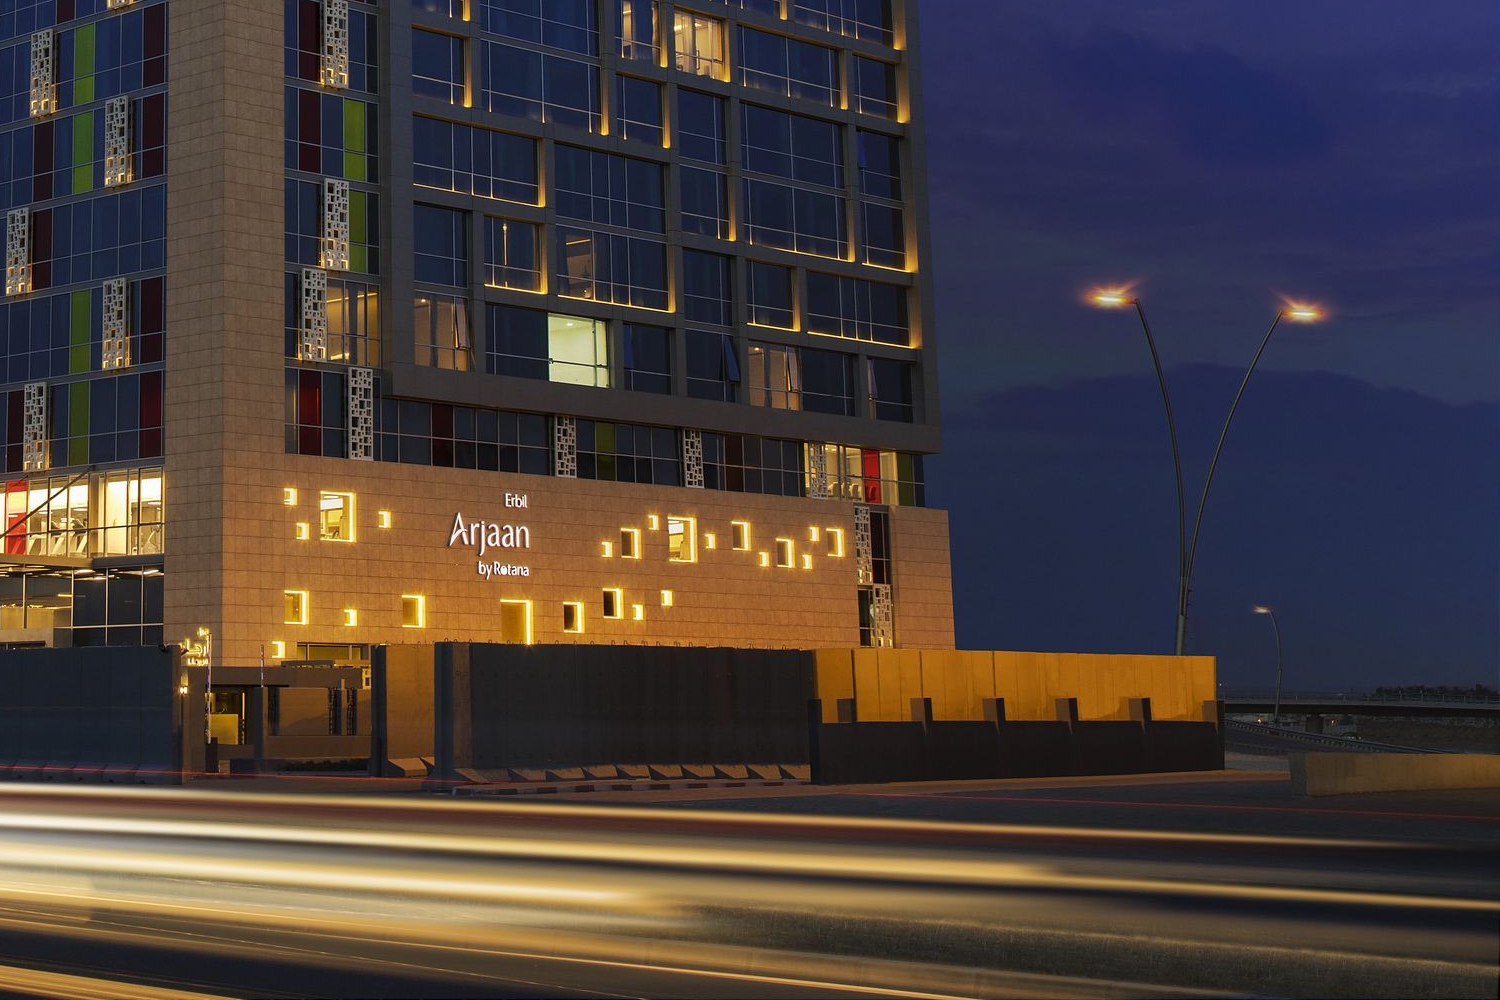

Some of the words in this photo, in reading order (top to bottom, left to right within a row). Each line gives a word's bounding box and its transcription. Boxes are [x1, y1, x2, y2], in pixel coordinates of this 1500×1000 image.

[505, 493, 528, 508] Erbil
[449, 511, 530, 556] Arjaan
[478, 560, 493, 580] by
[493, 561, 530, 577] Rotana
